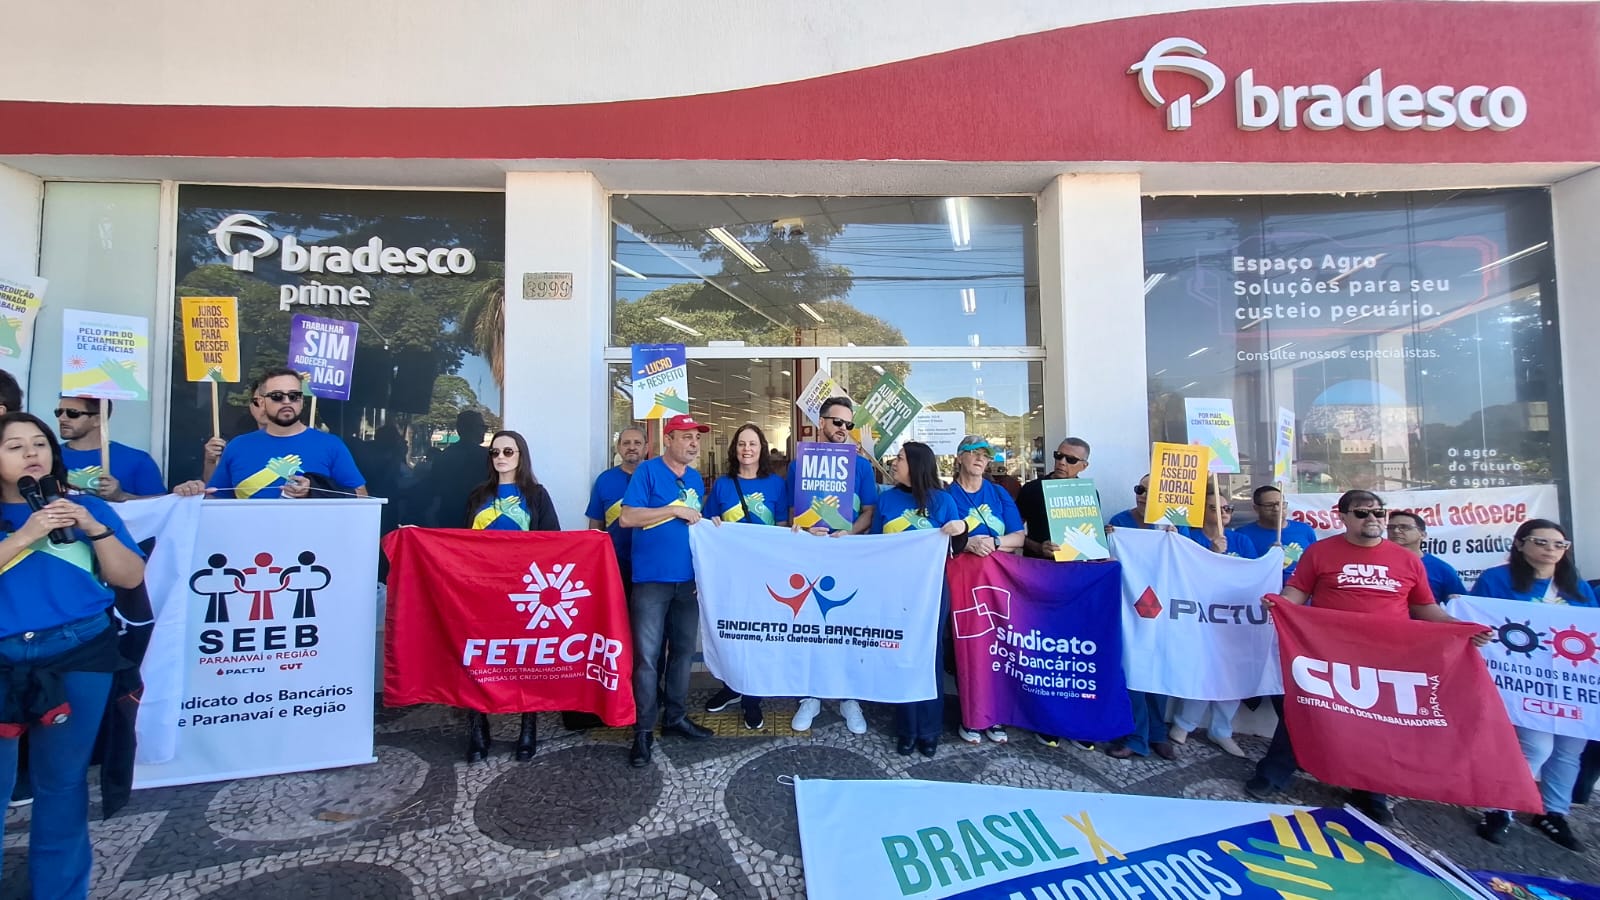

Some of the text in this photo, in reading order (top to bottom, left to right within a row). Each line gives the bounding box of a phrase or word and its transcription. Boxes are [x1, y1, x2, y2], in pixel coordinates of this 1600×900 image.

[1235, 68, 1528, 131] bradesco
[280, 235, 476, 276] bradesco
[1233, 254, 1377, 275] Espaço Agro
[280, 280, 371, 311] prime
[526, 281, 570, 298] 3999
[1234, 278, 1450, 298] Soluções para seu
[197, 305, 222, 317] JUROS
[1235, 300, 1441, 322] custeio pecuário.
[191, 317, 229, 329] MENORES
[301, 320, 344, 335] TRABALHAR
[77, 335, 135, 347] FECHAMENTO
[79, 327, 133, 339] PELO FIM DO
[201, 329, 222, 340] PARA
[77, 342, 135, 354] DE AGÊNCIAS
[195, 340, 229, 351] CRESCER
[303, 330, 350, 361] SIM
[1236, 346, 1441, 361] Consulte nossos especialistas.
[203, 352, 223, 364] MAIS
[645, 357, 672, 375] LUCRO
[313, 365, 345, 387] NÃO
[646, 367, 684, 389] RESPEITO
[877, 383, 912, 419] AUMENTO
[864, 391, 901, 437] REAL
[1162, 452, 1198, 468] FIM DO
[1448, 448, 1497, 459] O agro
[802, 455, 849, 480] MAIS
[1449, 461, 1521, 471] do futuro
[802, 479, 847, 492] EMPREGOS
[1160, 479, 1195, 494] MORAL
[1449, 476, 1511, 488] é agora.
[1049, 495, 1096, 508] LUTAR PARA
[1158, 493, 1195, 505] E SEXUAL
[1050, 506, 1098, 519] CONQUISTAR
[1448, 502, 1527, 526] adoece
[1452, 539, 1461, 553] e
[1466, 534, 1512, 553] saúde
[1343, 563, 1389, 577] CUT
[717, 619, 904, 640] SINDICATO DOS BANCÁRIOS
[198, 624, 319, 655] SEEB
[719, 631, 763, 643] Umuarama,
[765, 634, 785, 642] Assis
[787, 634, 843, 645] Chateaubriand
[852, 636, 878, 648] Região
[996, 624, 1097, 655] sindicato
[199, 653, 264, 665] PARANAVAÍ
[275, 649, 318, 660] REGIÃO
[989, 641, 1097, 673] dos bancários
[225, 667, 265, 675] PACTU
[279, 662, 303, 671] CUT
[992, 660, 1097, 691] e financiários
[1535, 667, 1559, 679] DOS
[587, 664, 618, 690] CUT
[1291, 655, 1428, 715] CUT
[243, 691, 273, 704] dos
[278, 685, 353, 701] Bancários
[1021, 684, 1050, 696] Curitiba
[1056, 691, 1080, 699] região
[1429, 675, 1444, 717] PARANÁ
[1495, 674, 1558, 699] ARAPOTI
[1563, 686, 1573, 701] E
[192, 707, 274, 726] Paranavaí
[278, 709, 288, 717] e
[293, 701, 346, 717] Região
[1296, 696, 1331, 710] CENTRAL
[1332, 701, 1357, 715] ÚNICA
[1523, 697, 1578, 719] CUT
[881, 809, 1127, 896] BRASIL X
